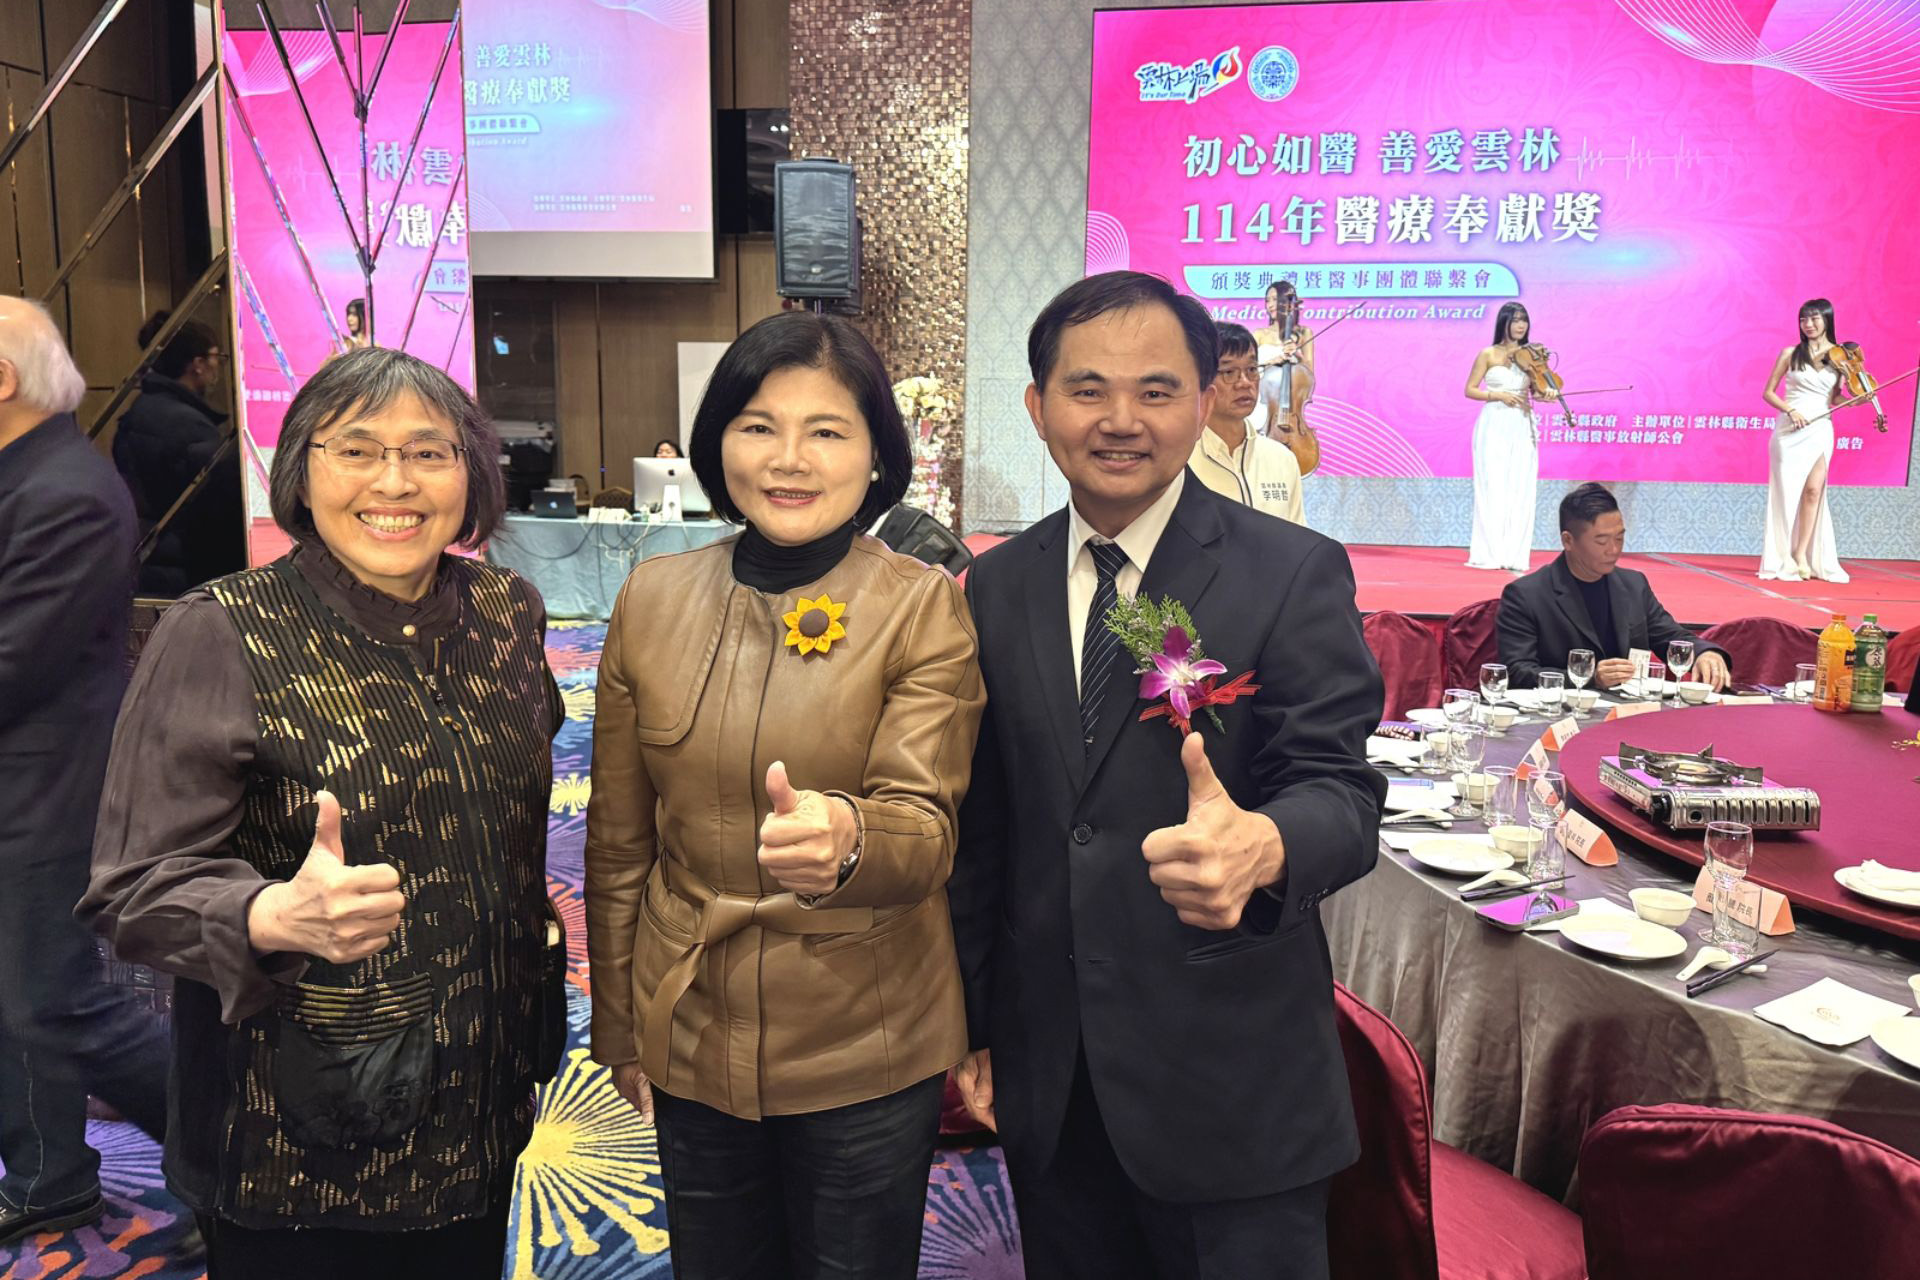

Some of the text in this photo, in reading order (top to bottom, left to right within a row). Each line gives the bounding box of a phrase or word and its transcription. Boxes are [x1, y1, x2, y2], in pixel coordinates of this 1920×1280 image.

[476, 42, 551, 68] 善愛雲林
[1183, 127, 1561, 178] 初心如醫 善愛雲林
[1180, 191, 1602, 245] 114年醫療奉獻獎
[1210, 304, 1267, 321] Medic
[1424, 304, 1487, 319] Award
[1836, 437, 1864, 450] 廣告
